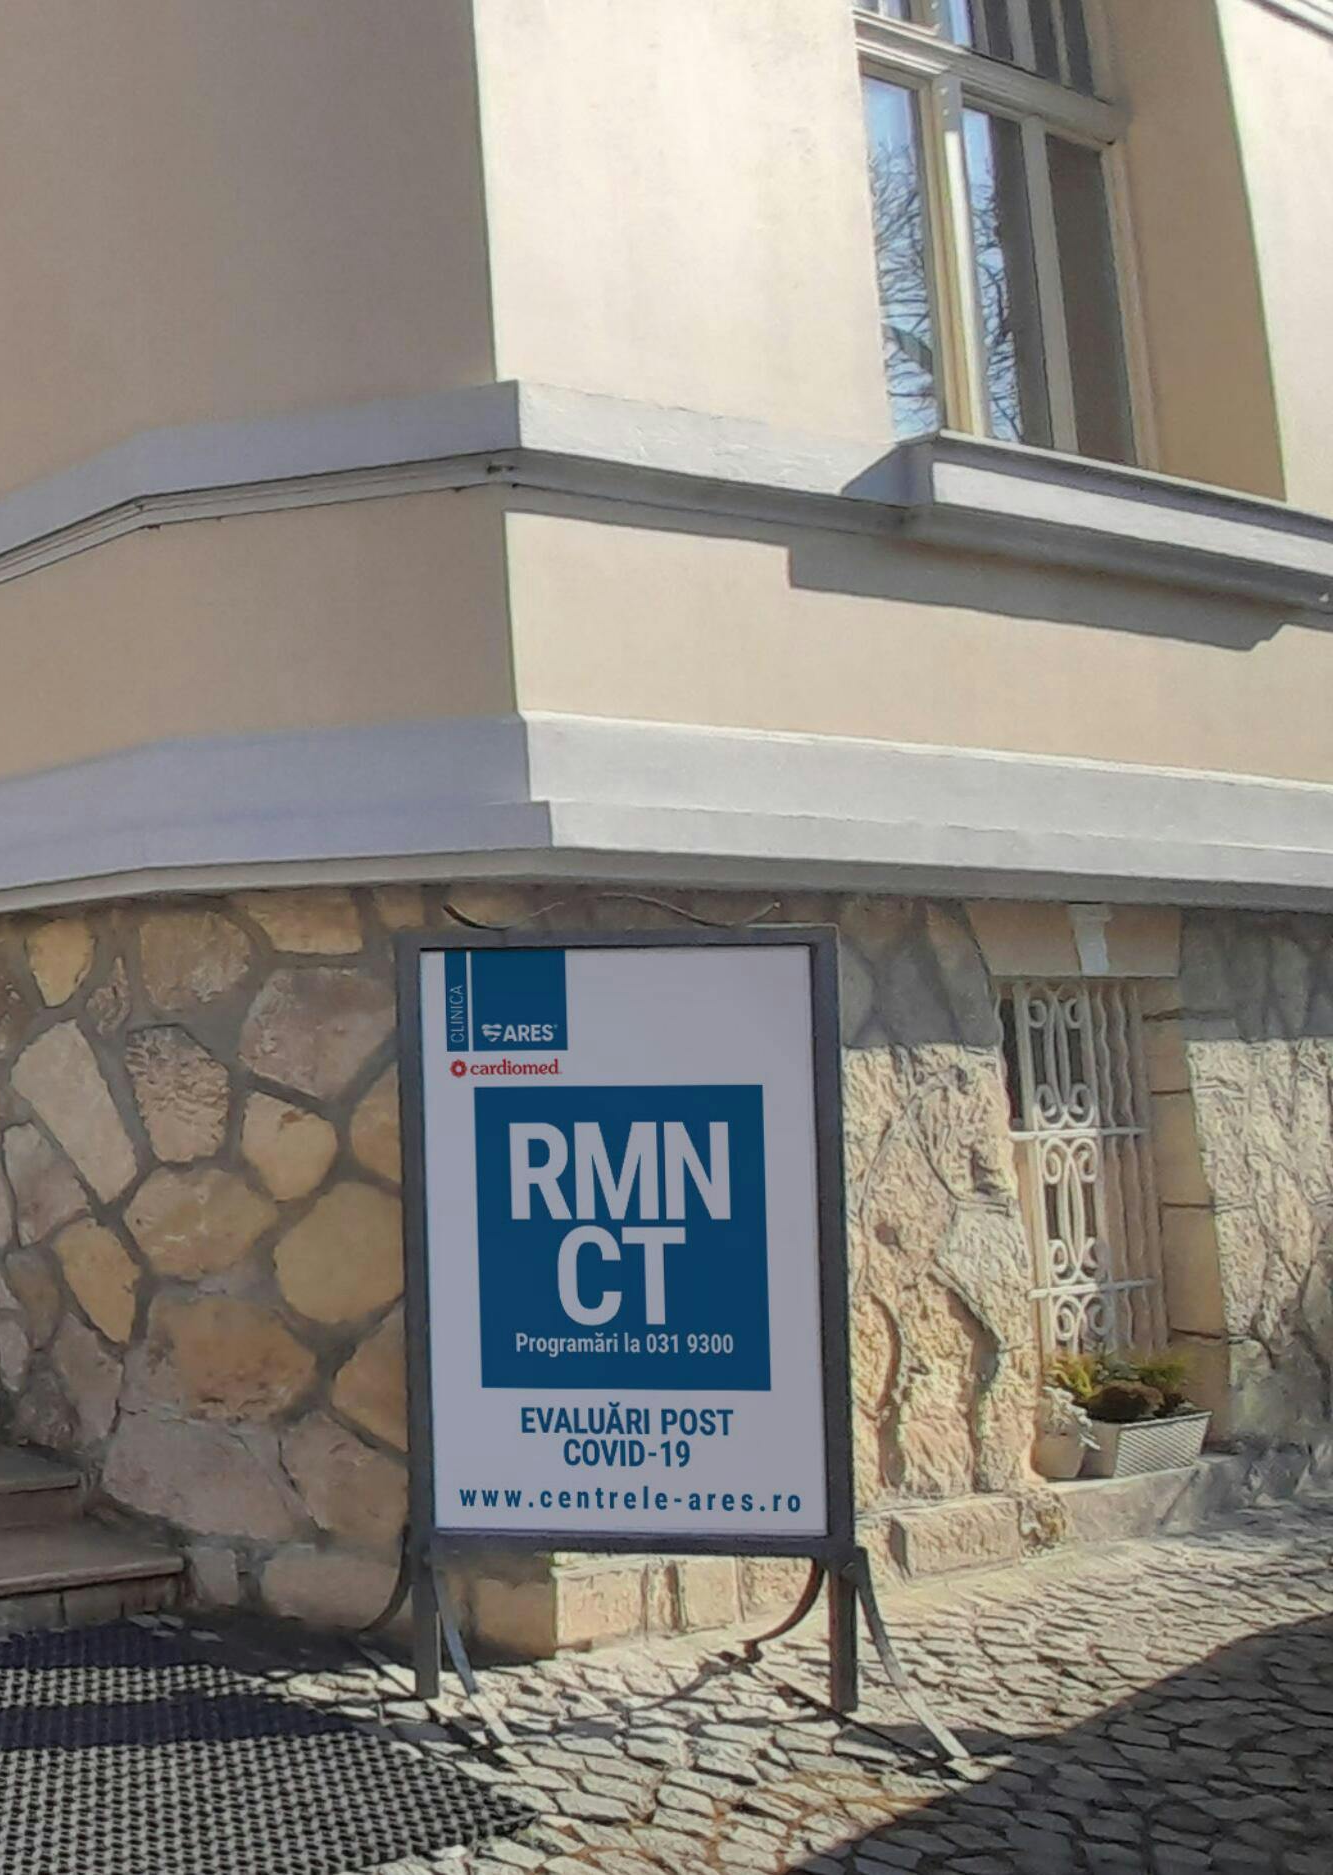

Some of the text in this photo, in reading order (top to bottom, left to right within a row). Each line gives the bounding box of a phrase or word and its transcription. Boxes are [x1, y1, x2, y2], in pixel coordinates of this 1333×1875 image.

[449, 985, 465, 1043] CLINICA
[502, 1024, 554, 1042] ARES
[469, 1058, 560, 1076] cardiomed
[508, 1121, 731, 1220] RMN
[557, 1225, 686, 1326] CT
[515, 1332, 734, 1358] Programări la 031 9300
[520, 1401, 734, 1436] EVALUĂRI POST
[563, 1438, 691, 1468] COVID-19
[459, 1485, 801, 1513] www.centrele-ares.ro
